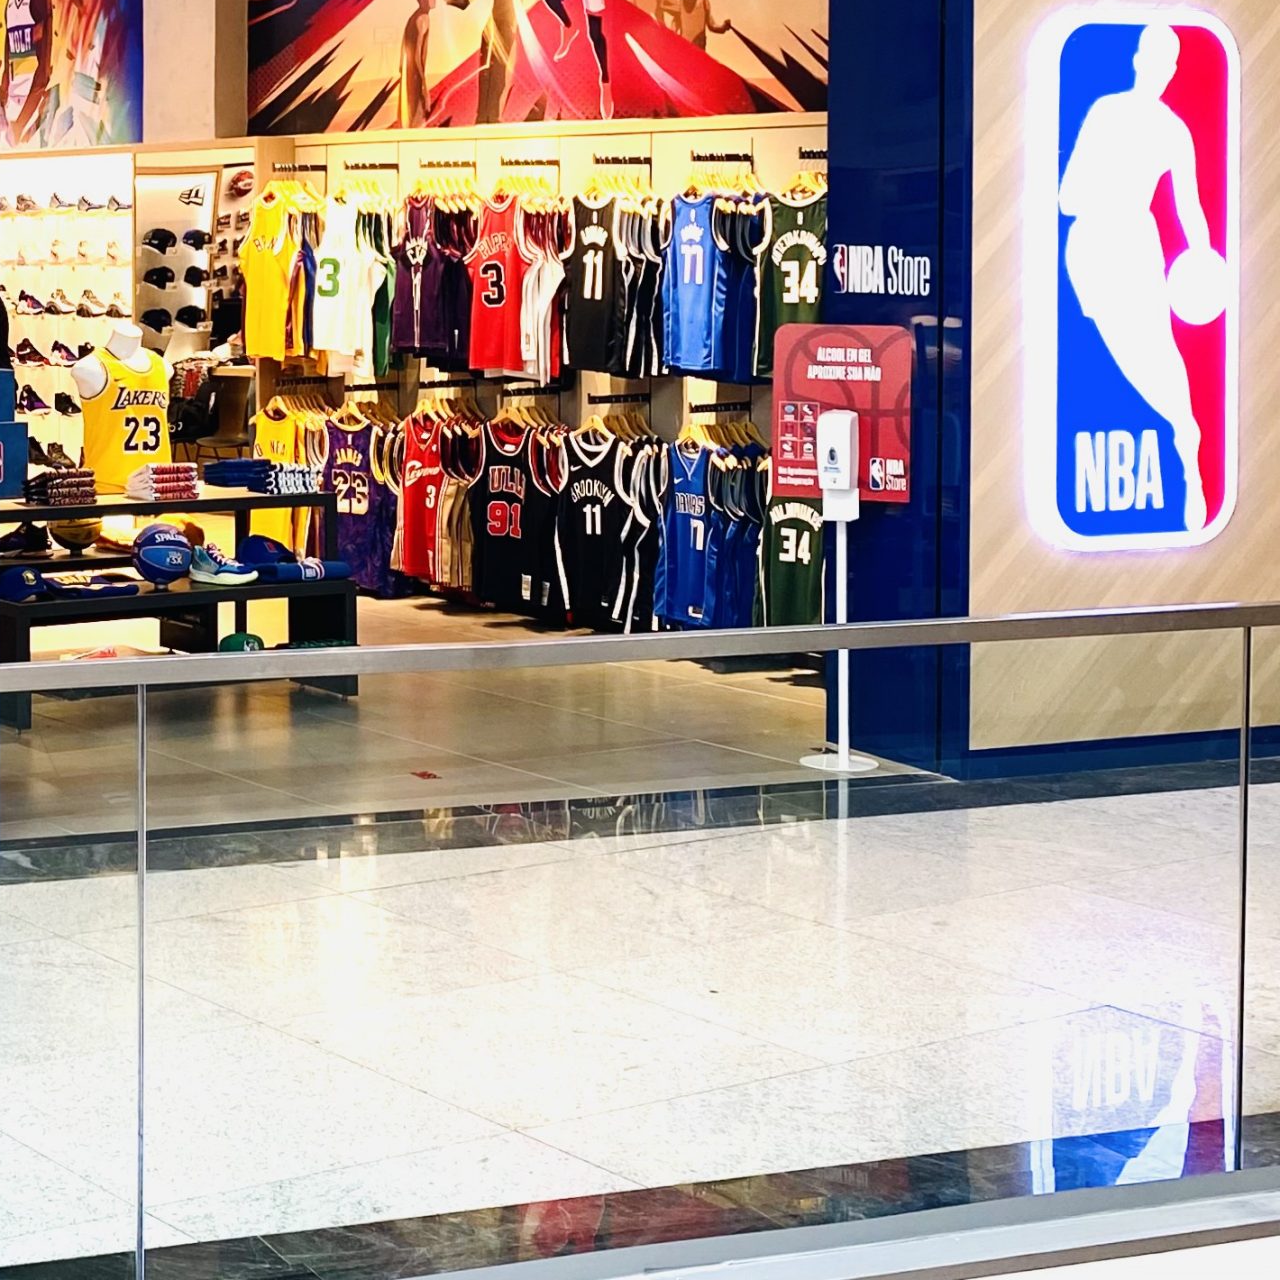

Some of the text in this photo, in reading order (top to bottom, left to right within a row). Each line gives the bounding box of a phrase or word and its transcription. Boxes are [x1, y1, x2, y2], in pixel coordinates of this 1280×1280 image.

[317, 258, 341, 297] 3
[582, 249, 604, 300] 11
[780, 260, 819, 304] 34
[848, 245, 885, 294] NBA
[887, 245, 931, 297] Store
[111, 386, 167, 411] LAKERS
[124, 416, 161, 452] 23
[886, 459, 905, 475] NBA
[886, 475, 907, 491] Store
[1075, 429, 1164, 513] NBA
[571, 479, 615, 507] BROOKLYN
[487, 501, 521, 539] 91
[583, 504, 602, 535] 11
[779, 527, 811, 565] 34
